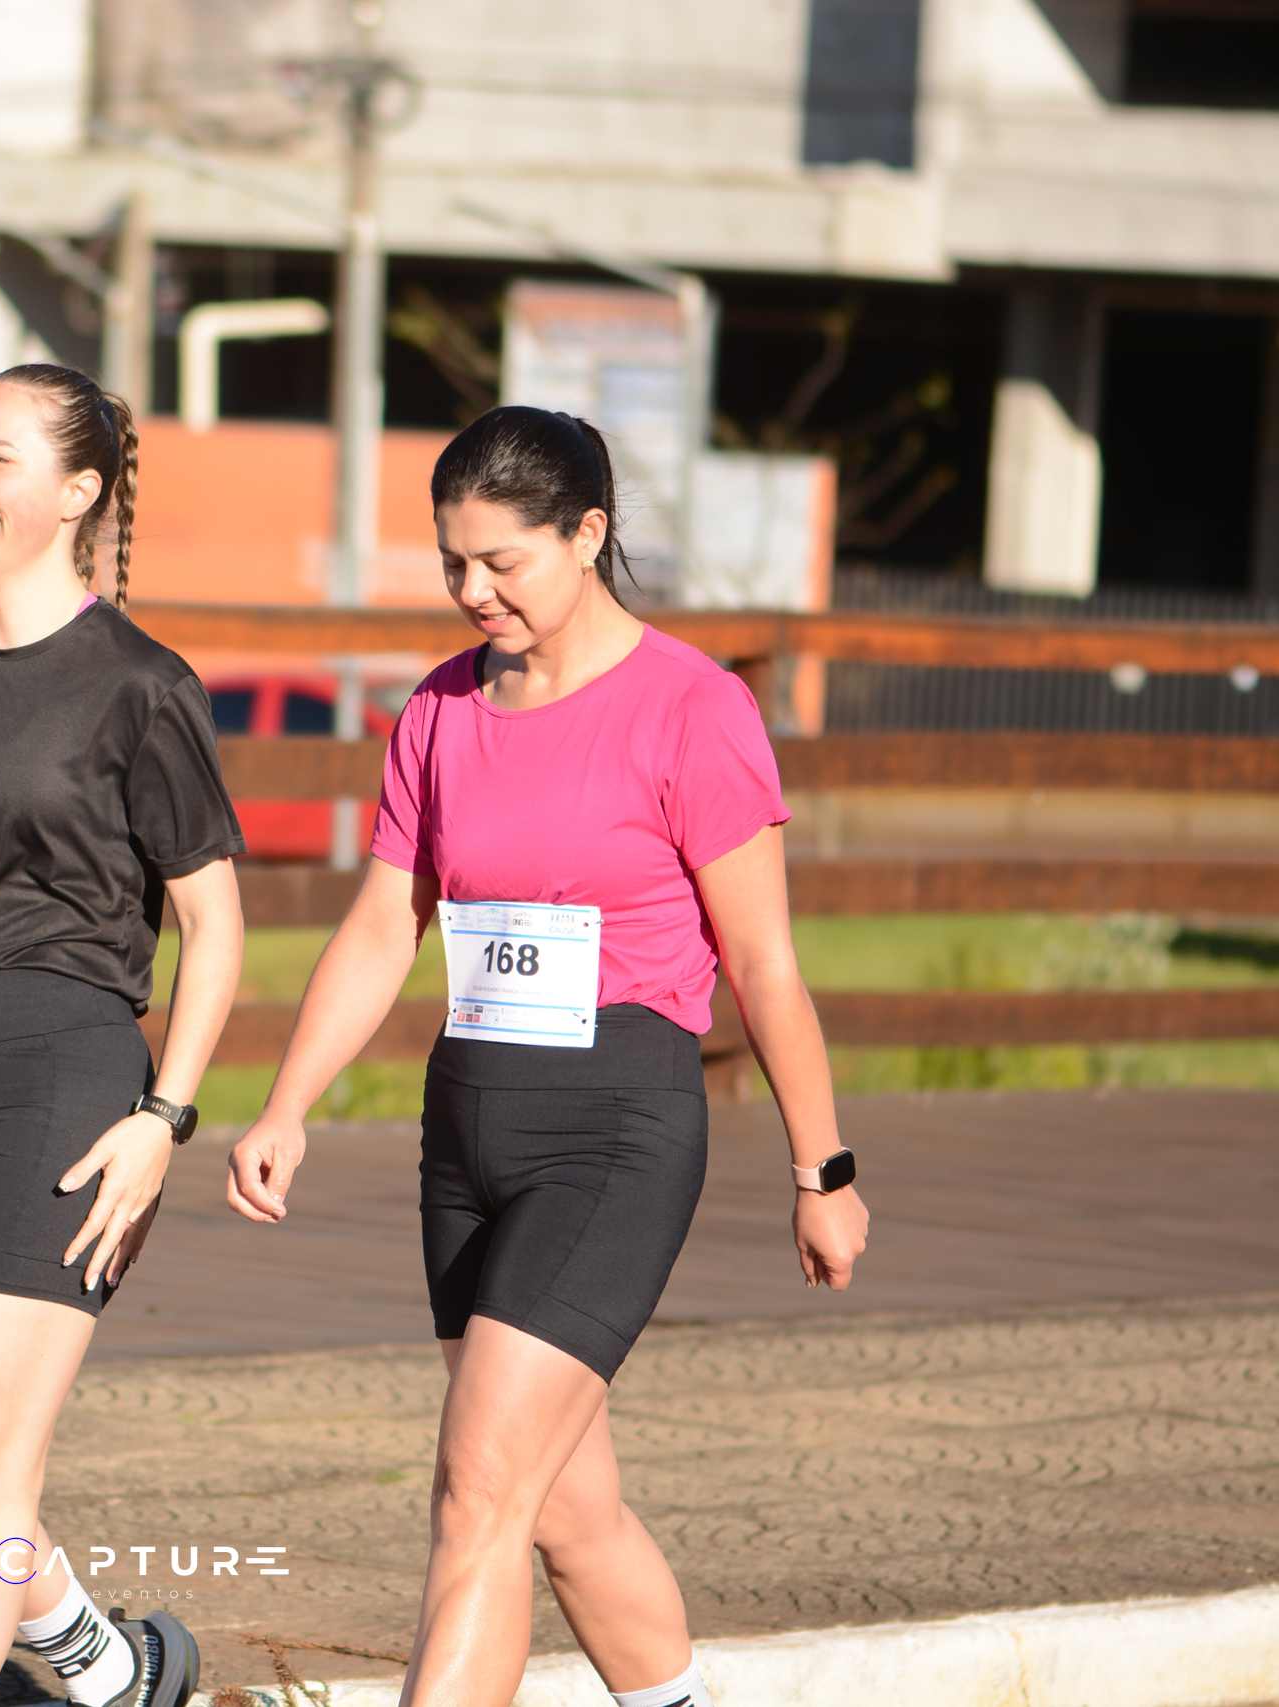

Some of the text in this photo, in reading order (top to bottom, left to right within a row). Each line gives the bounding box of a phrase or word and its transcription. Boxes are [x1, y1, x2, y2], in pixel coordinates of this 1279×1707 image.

[549, 926, 575, 935] CAUSA
[484, 941, 539, 976] 168
[501, 987, 518, 995] FRANÇA
[141, 1634, 159, 1681] TURBO
